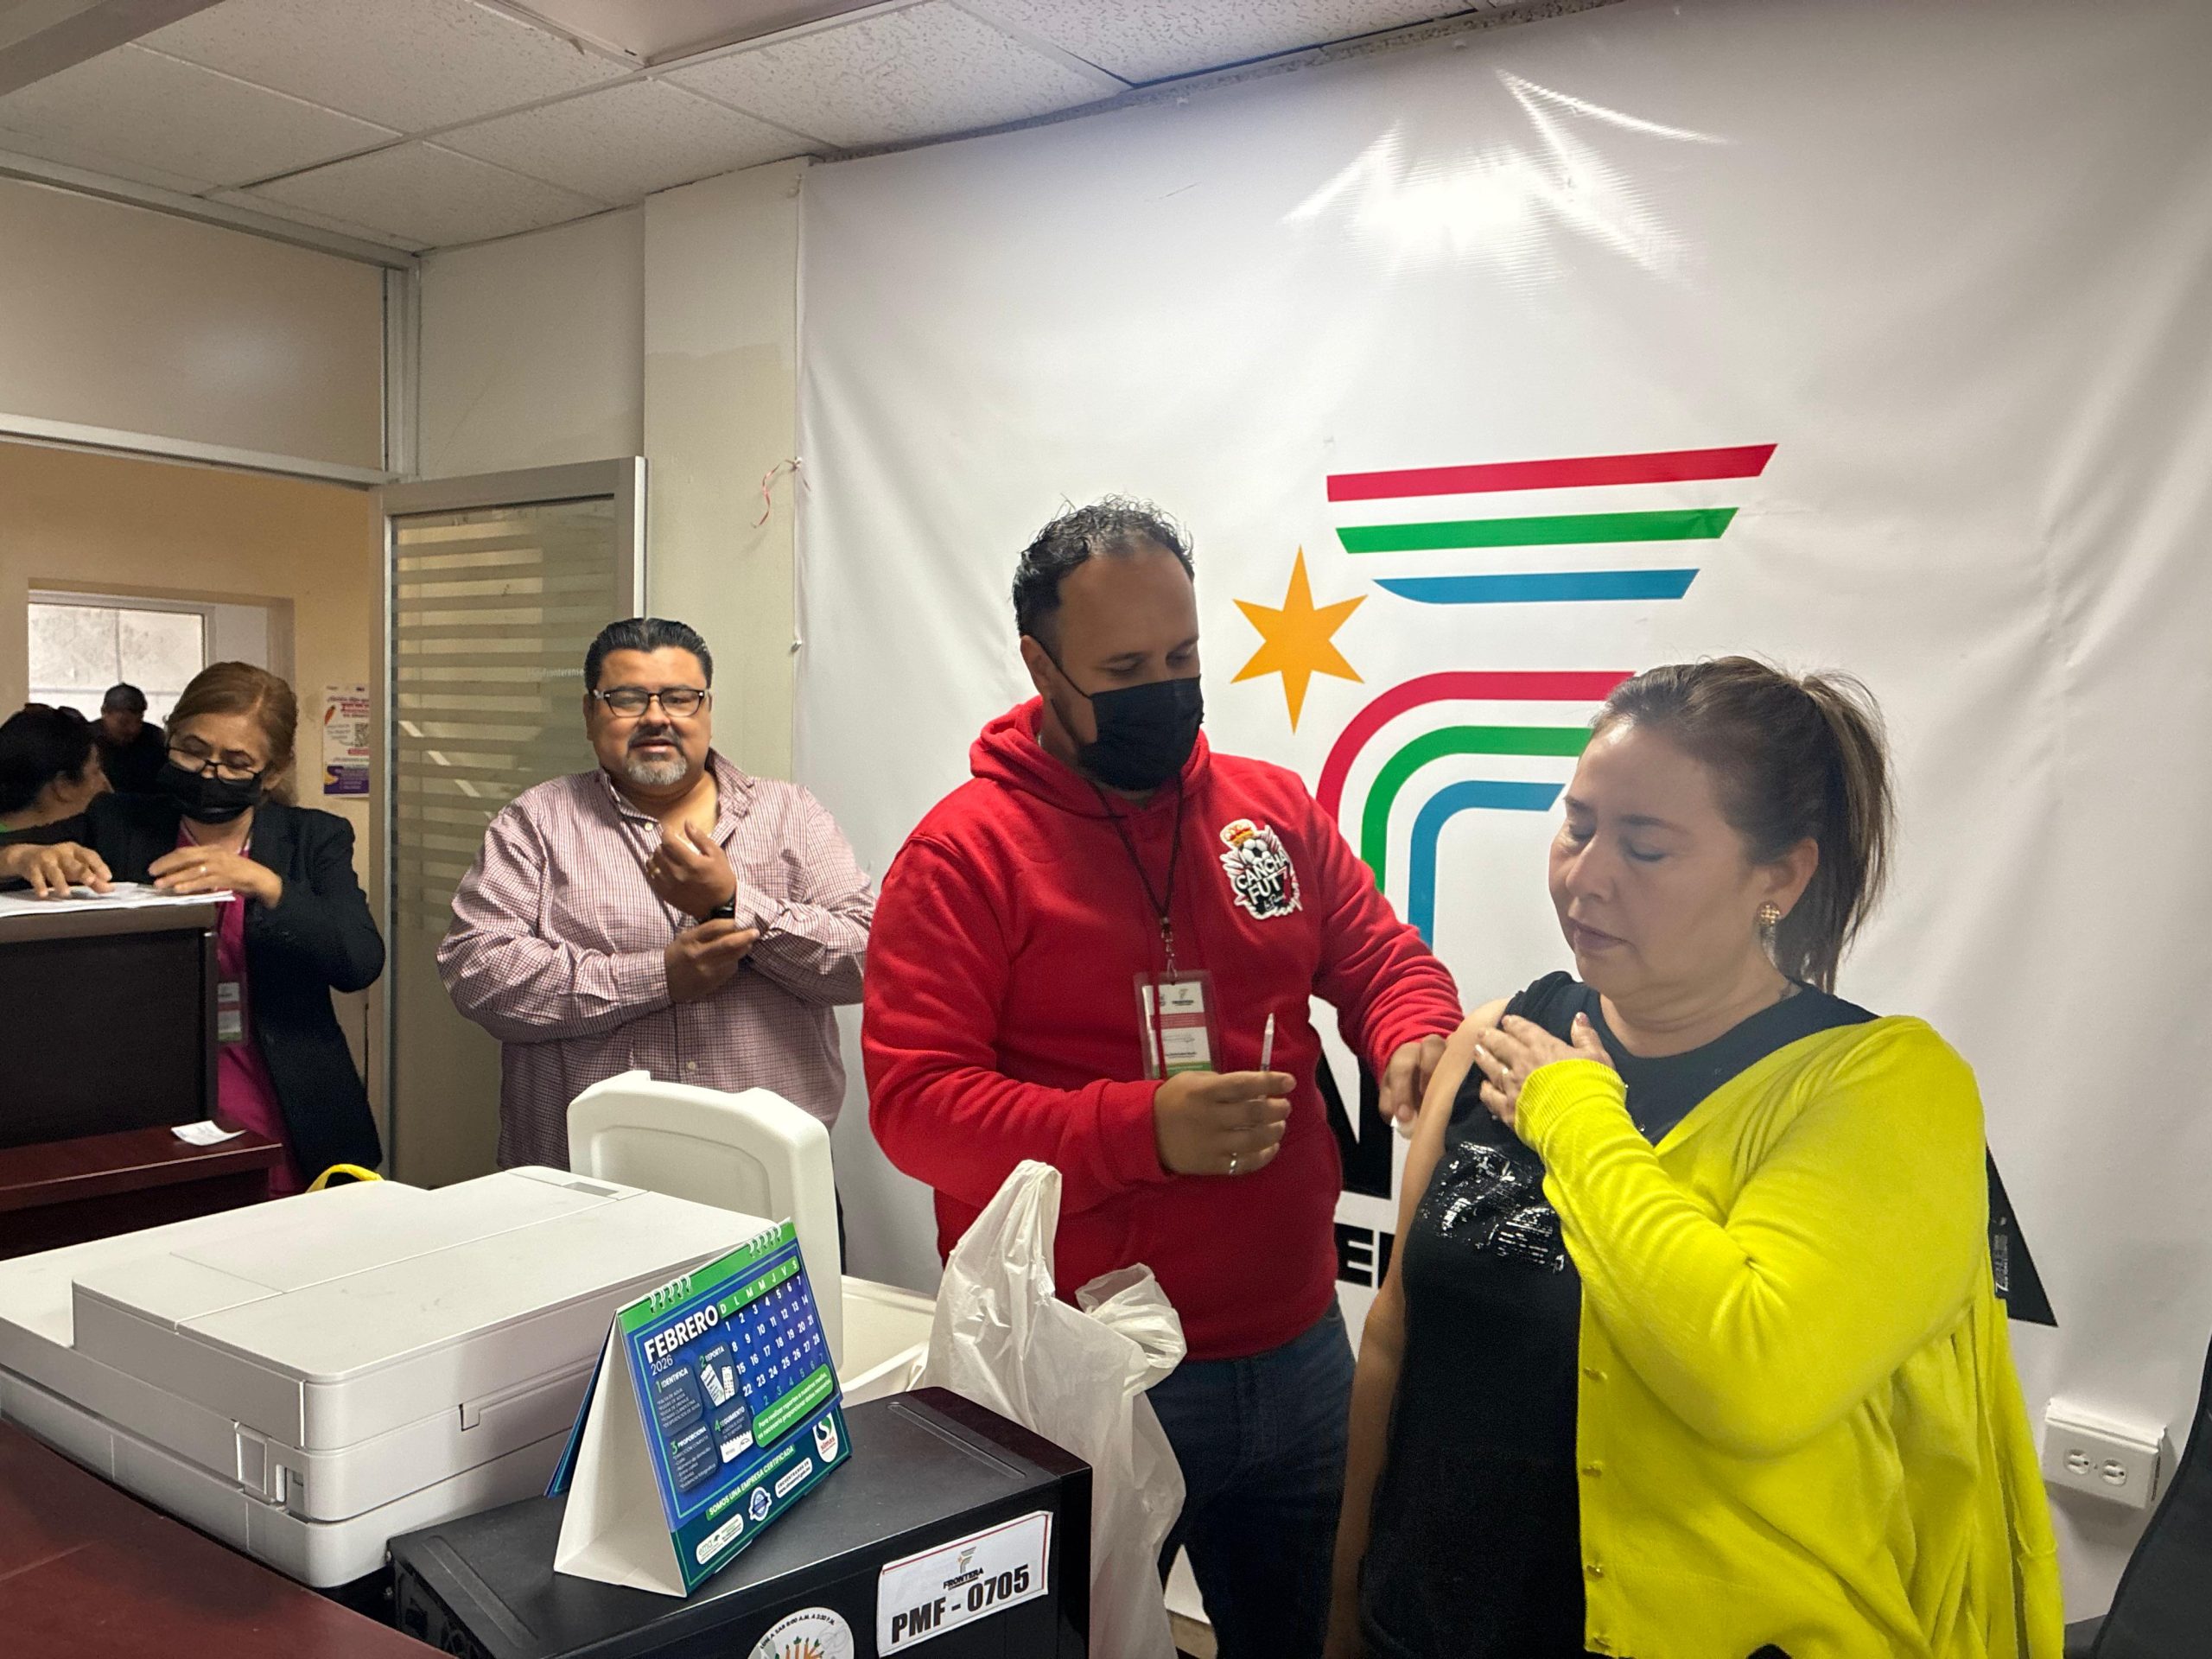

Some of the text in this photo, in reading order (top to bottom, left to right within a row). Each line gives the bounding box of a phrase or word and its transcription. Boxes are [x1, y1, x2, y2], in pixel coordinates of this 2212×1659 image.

[1236, 850, 1288, 889] CANCHA
[720, 1260, 798, 1314] D L M M J V S
[725, 1275, 802, 1332] 1 2 3 4 5 6 7
[645, 1306, 719, 1364] FEBRERO
[732, 1294, 809, 1352] 8 9 10 11 12 13 14
[736, 1314, 814, 1375] 15 16 17 18 19 20 21
[651, 1355, 673, 1376] 2026
[742, 1333, 820, 1397] 22 23 24 25 26 27 28
[763, 1395, 770, 1407] 2
[776, 1385, 782, 1396] 3
[789, 1376, 795, 1386] 4
[709, 1496, 730, 1516] SOMOS
[729, 1487, 742, 1500] UNA
[741, 1469, 764, 1491] EMPRESA
[764, 1446, 794, 1473] CERTIFICADA
[892, 1596, 946, 1643] PMF
[967, 1564, 1029, 1613] 0705
[944, 1567, 983, 1589] FRONTERA
